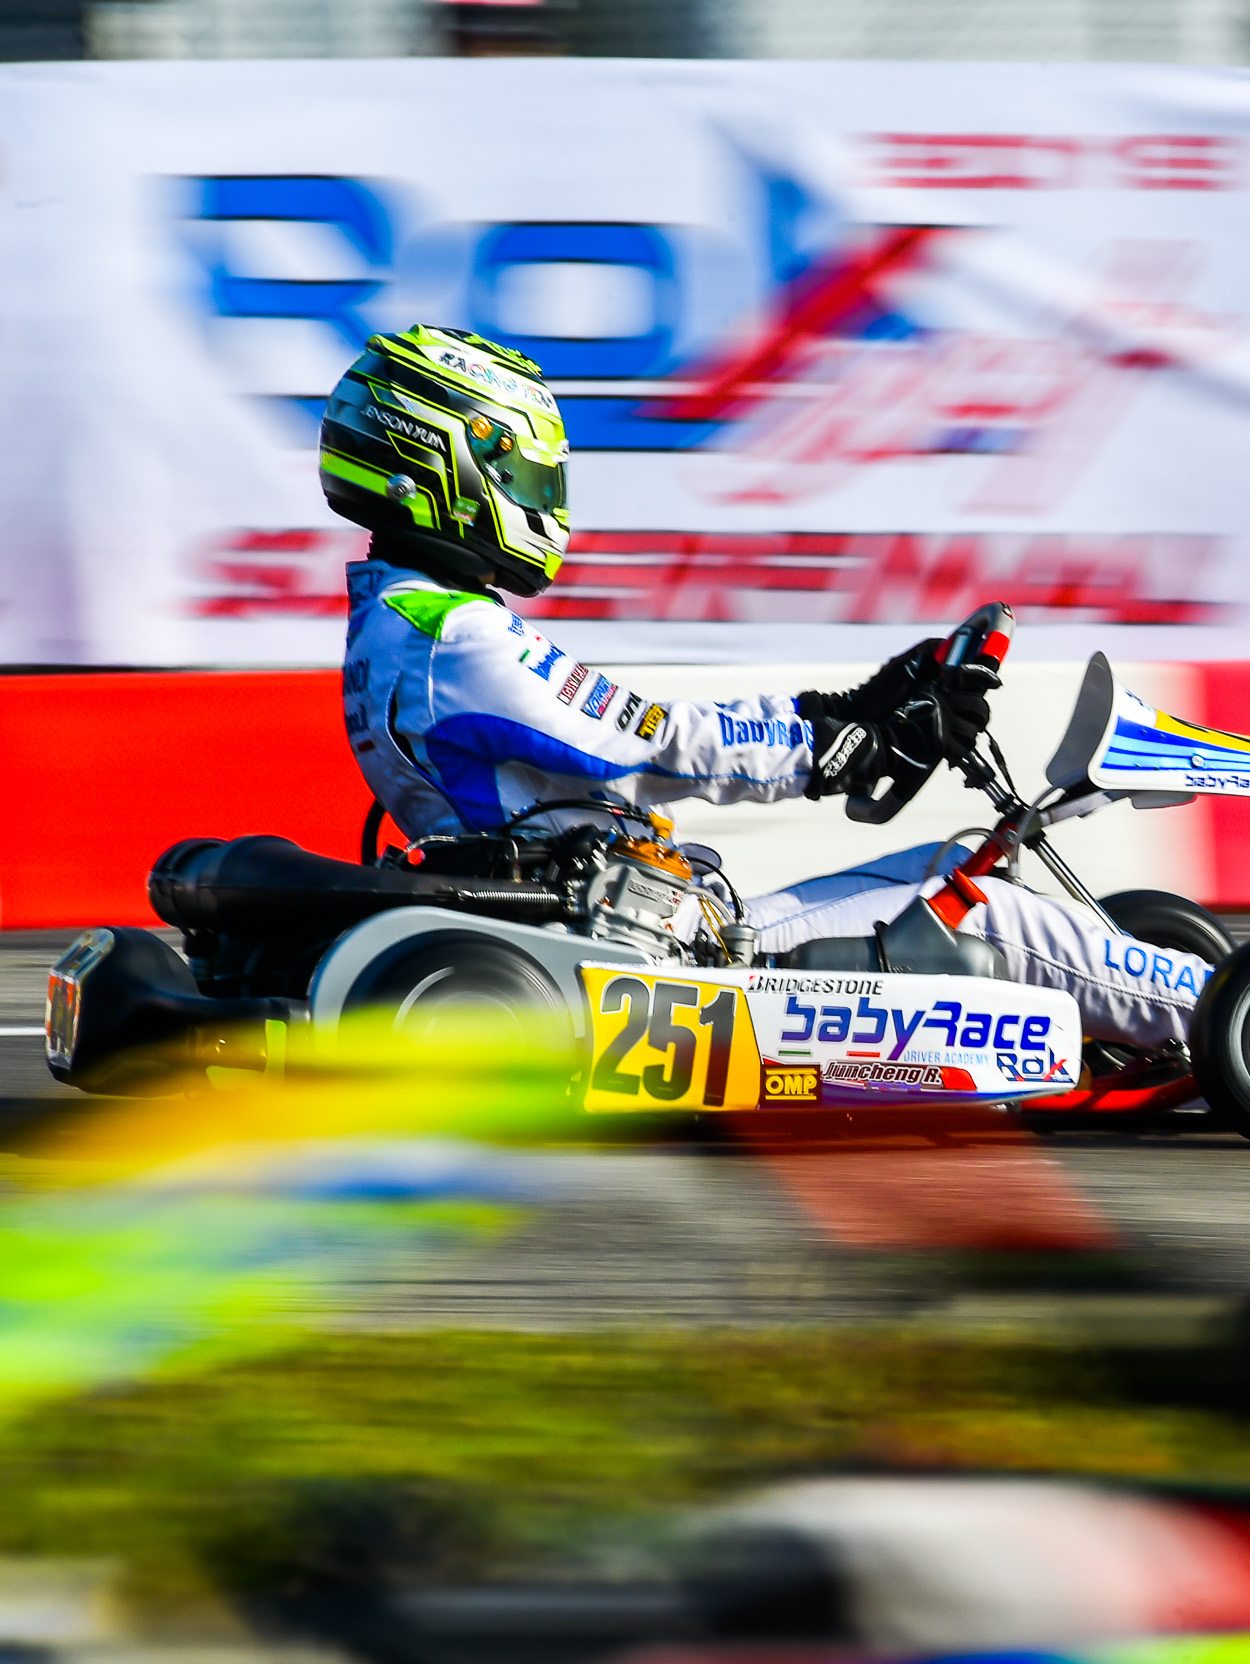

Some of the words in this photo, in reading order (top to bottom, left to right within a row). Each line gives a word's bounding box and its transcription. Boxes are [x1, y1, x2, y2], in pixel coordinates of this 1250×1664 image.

[746, 975, 884, 996] BRIDGESTONE
[591, 975, 737, 1107] 251
[903, 1050, 941, 1063] DRIVER
[944, 1052, 990, 1066] ACADEMY
[823, 1061, 921, 1084] Juncheng
[765, 1075, 817, 1095] OMP
